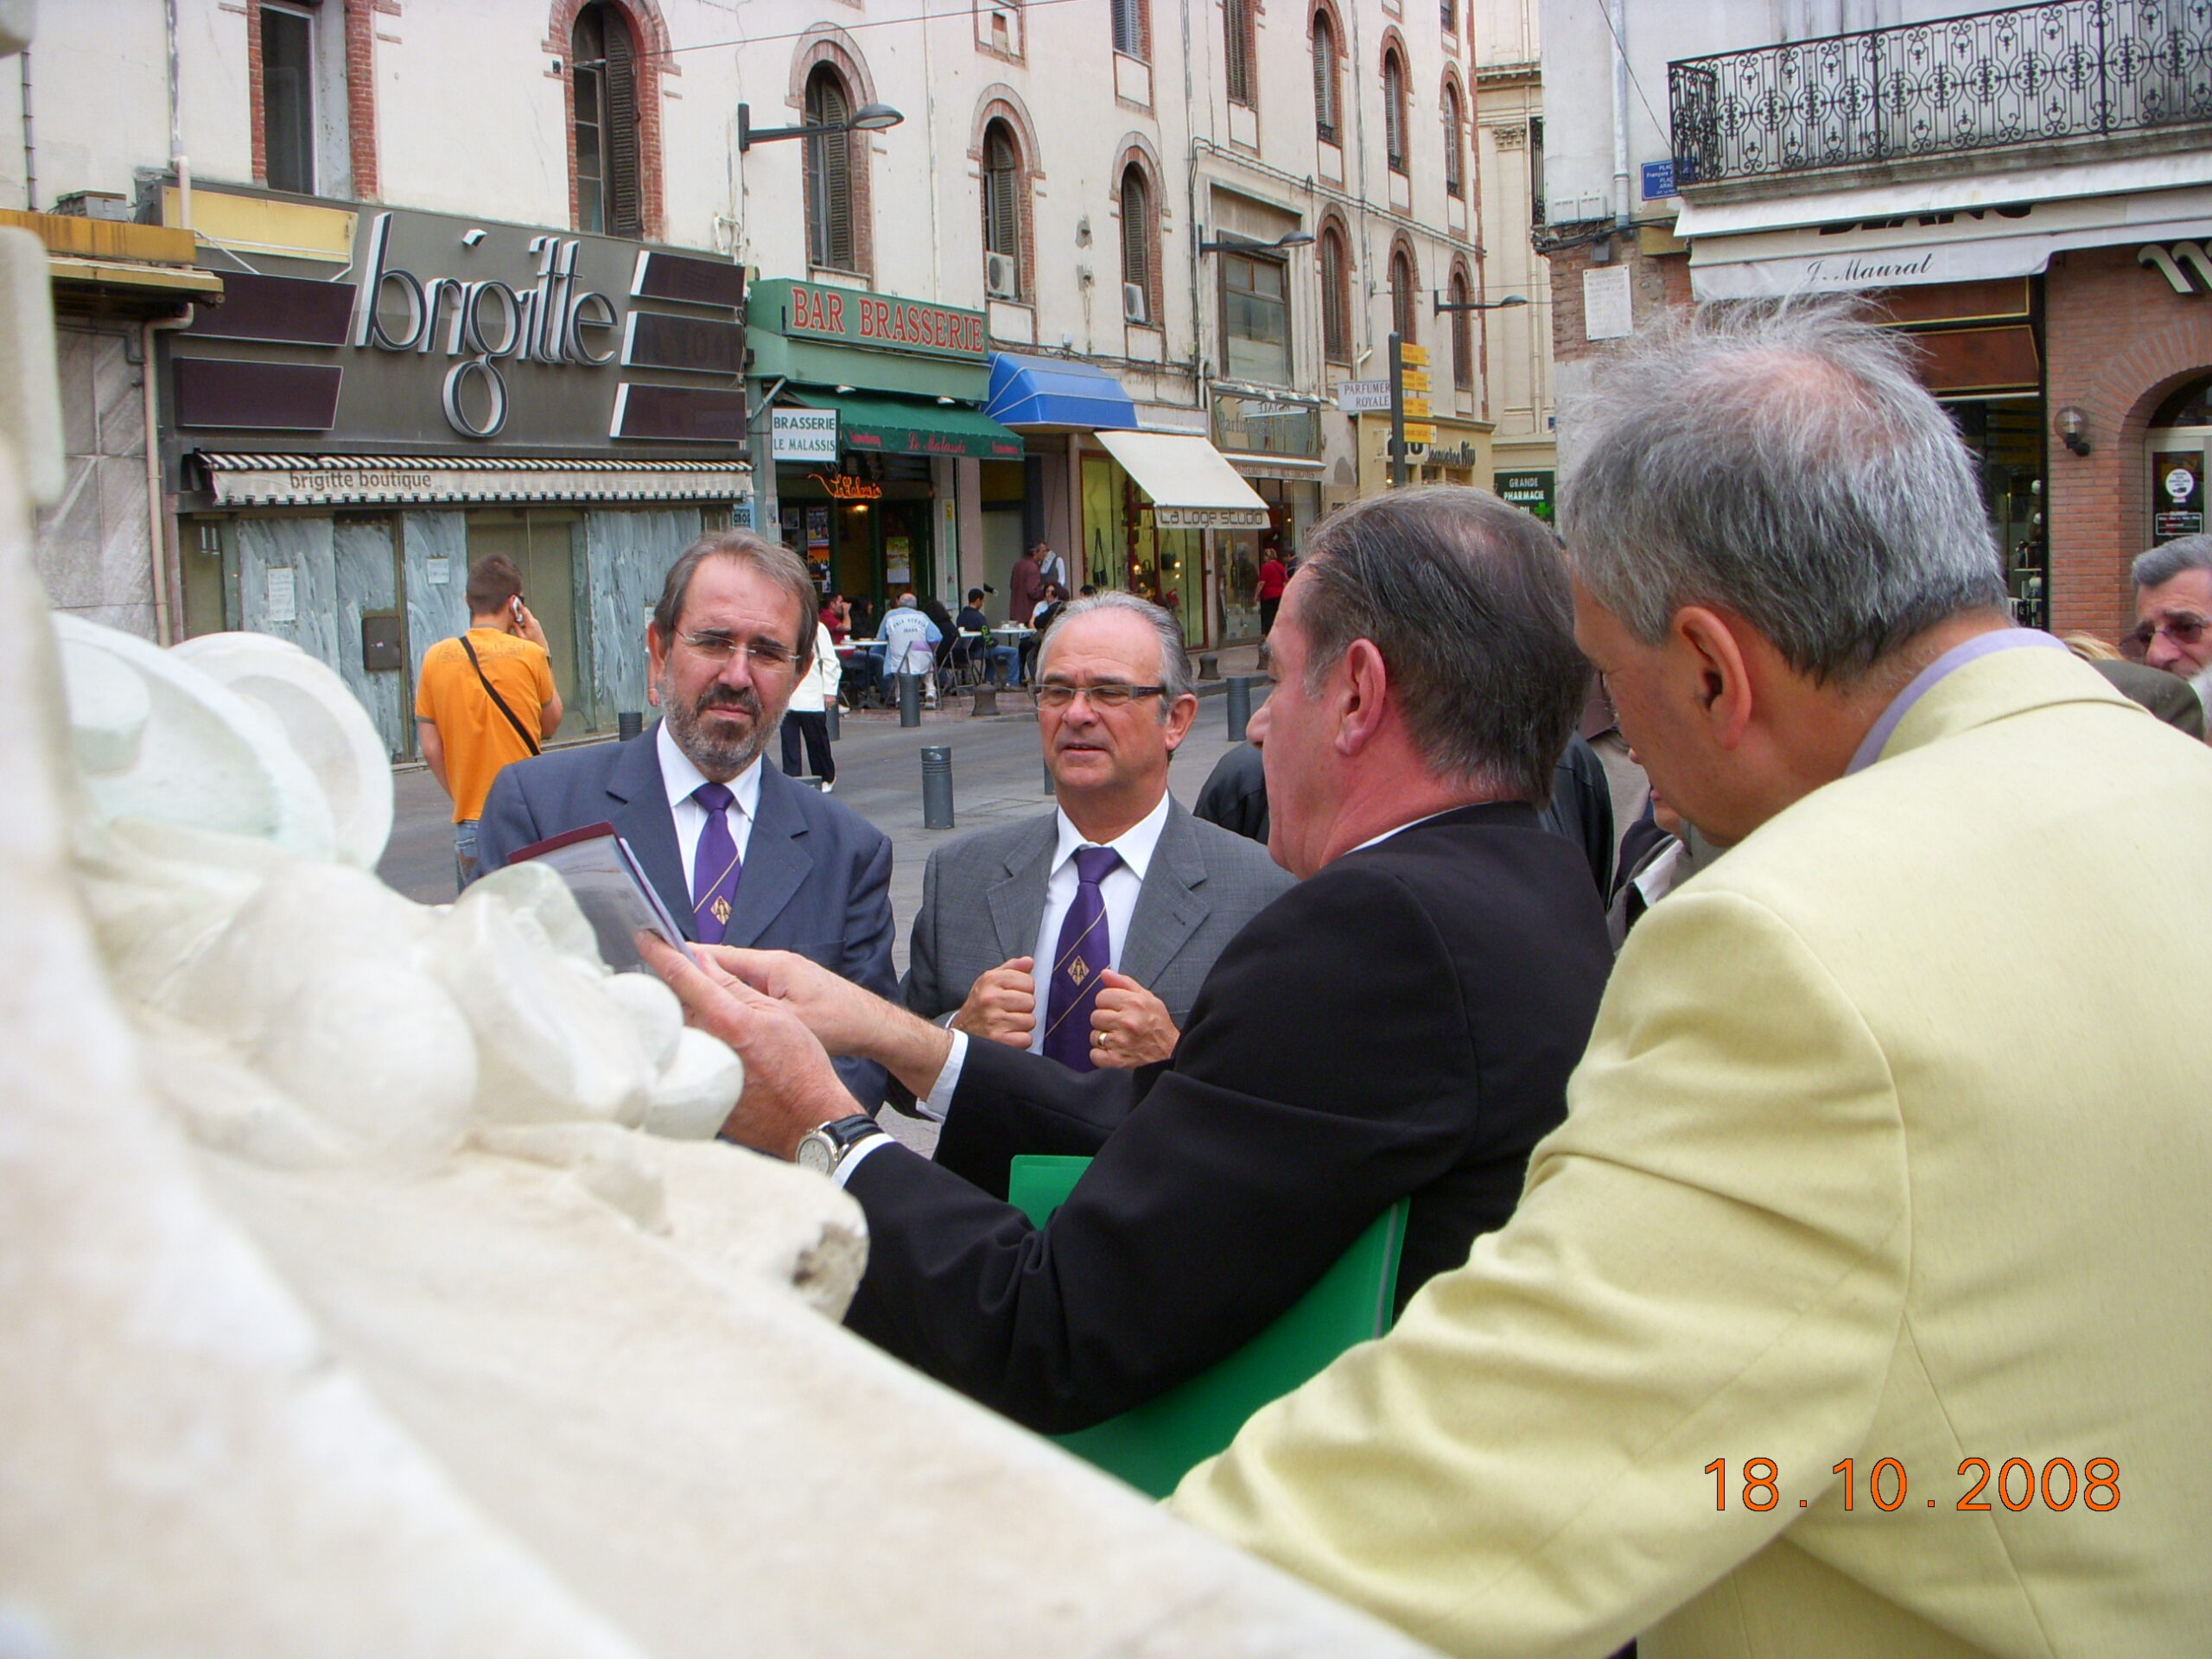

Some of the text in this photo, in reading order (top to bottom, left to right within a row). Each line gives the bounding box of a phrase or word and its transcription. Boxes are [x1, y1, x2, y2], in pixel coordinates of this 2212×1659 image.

[354, 212, 619, 438] brigitte
[791, 287, 985, 353] BAR BRASSERIE
[1344, 382, 1391, 395] PARFUMER
[1356, 395, 1390, 408] ROYALE
[773, 416, 836, 429] BRASSERIE
[773, 438, 785, 450] LE
[788, 437, 836, 452] MALASSIS
[289, 470, 431, 492] brigitte boutique
[1509, 478, 1538, 488] GRANDE
[1503, 490, 1545, 501] PHARMACIE
